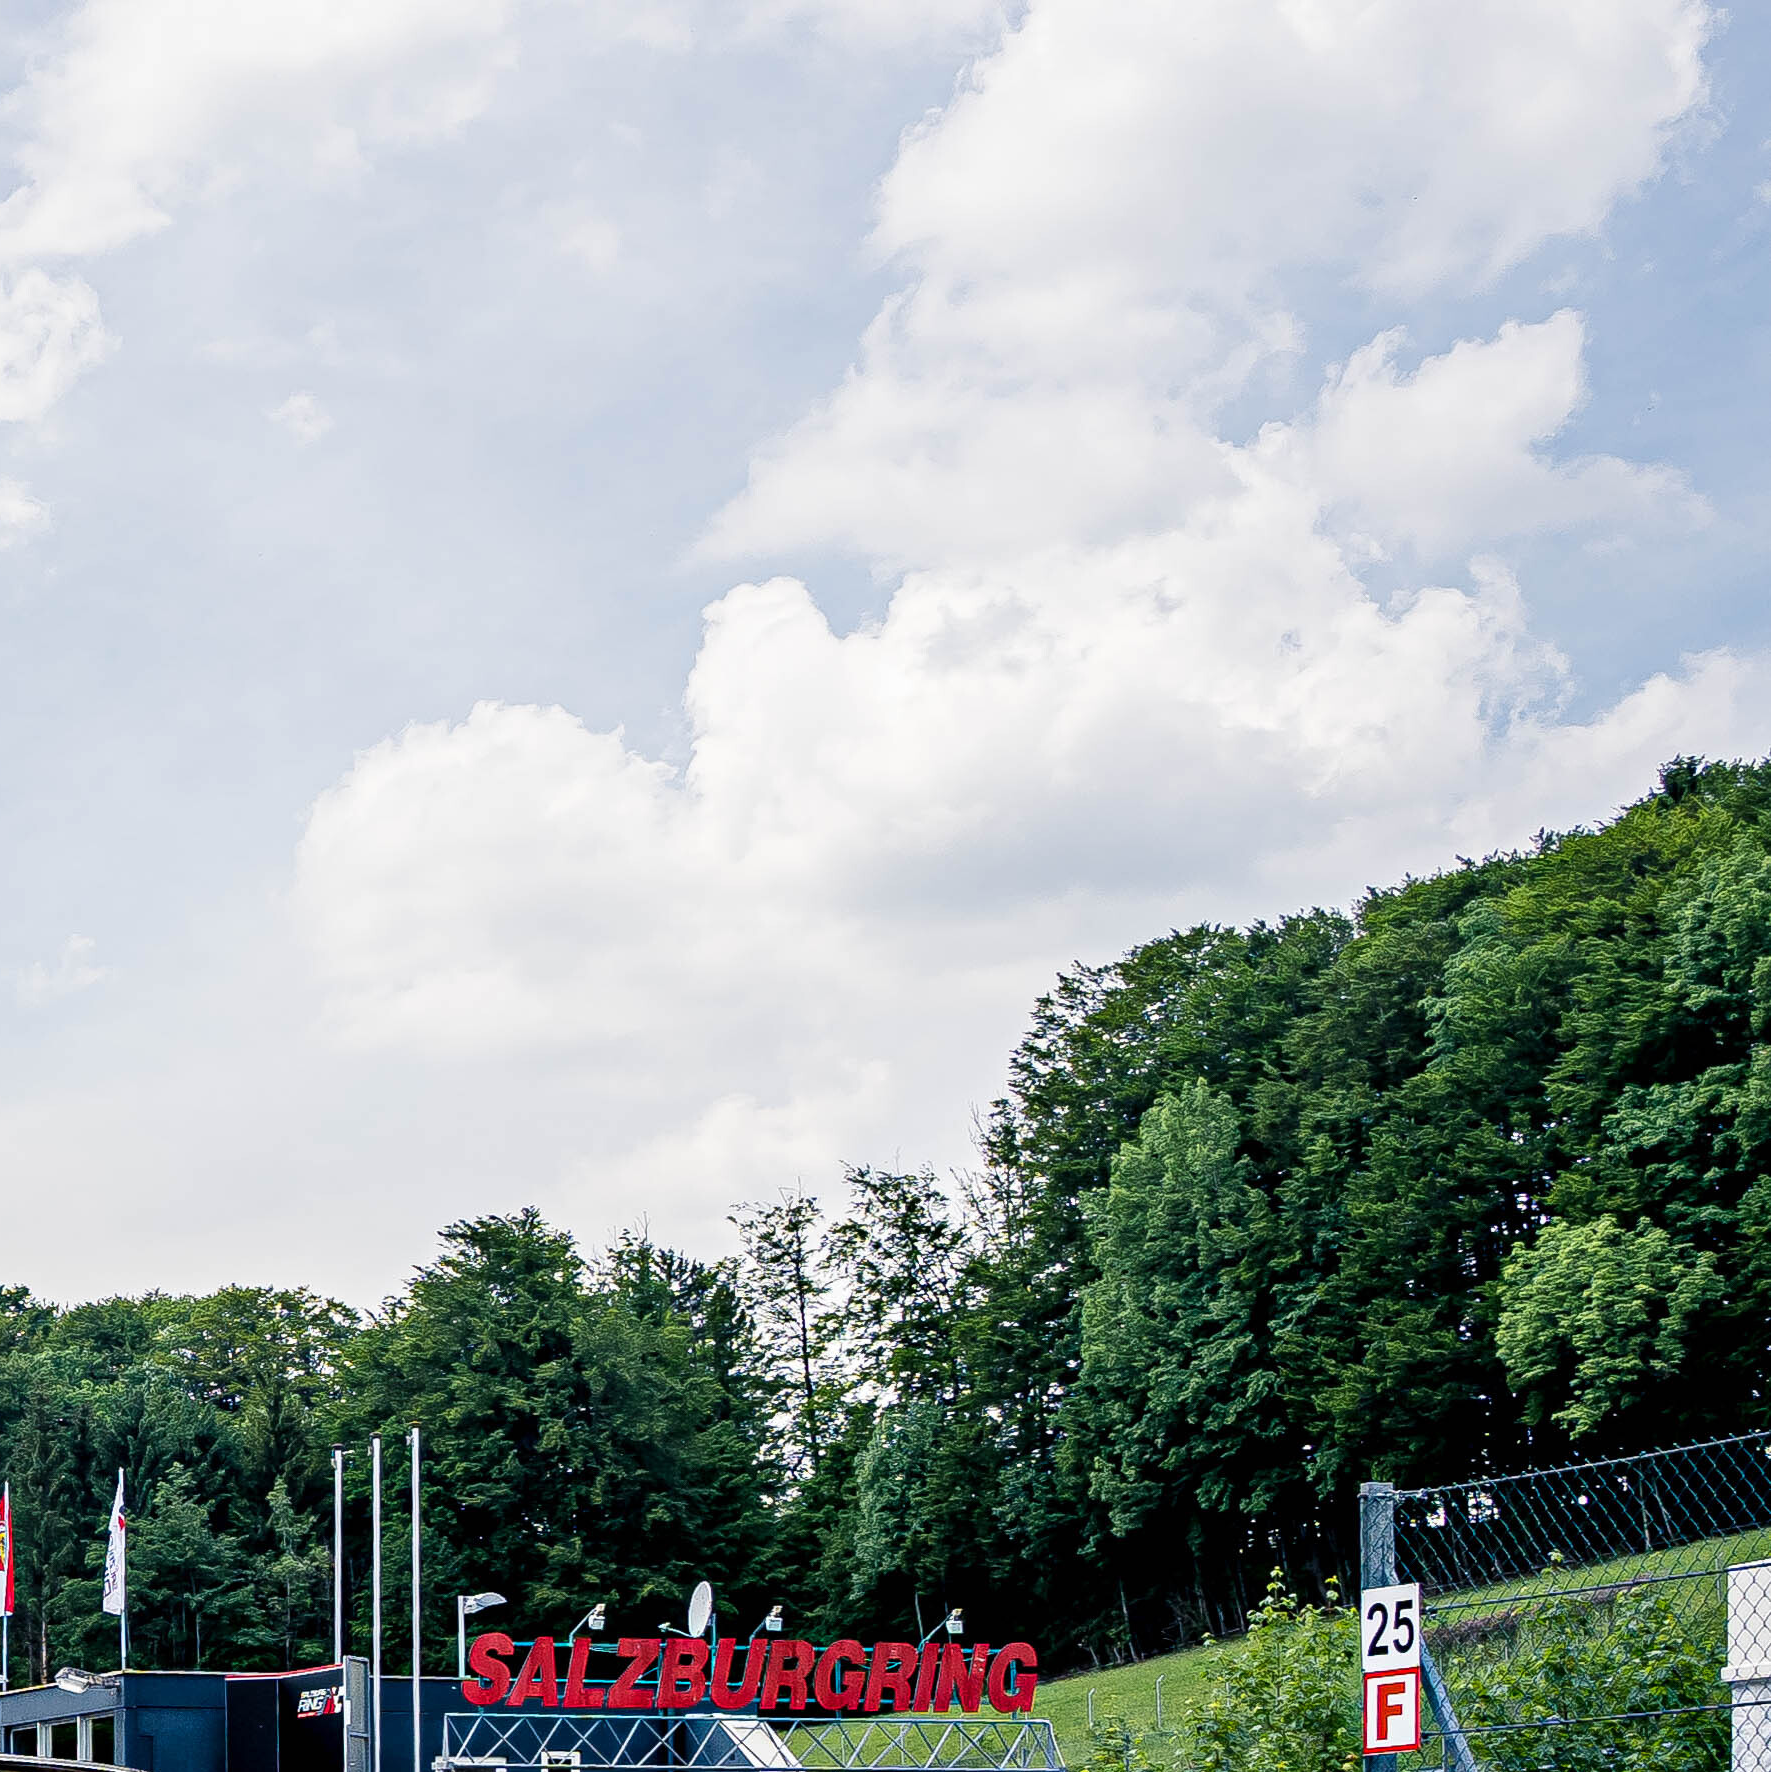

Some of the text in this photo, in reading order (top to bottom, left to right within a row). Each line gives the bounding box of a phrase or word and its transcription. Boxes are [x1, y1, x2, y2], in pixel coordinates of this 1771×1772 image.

[1367, 1599, 1414, 1656] 25
[461, 1632, 1037, 1713] SALZBURGRING
[1377, 1681, 1405, 1741] F
